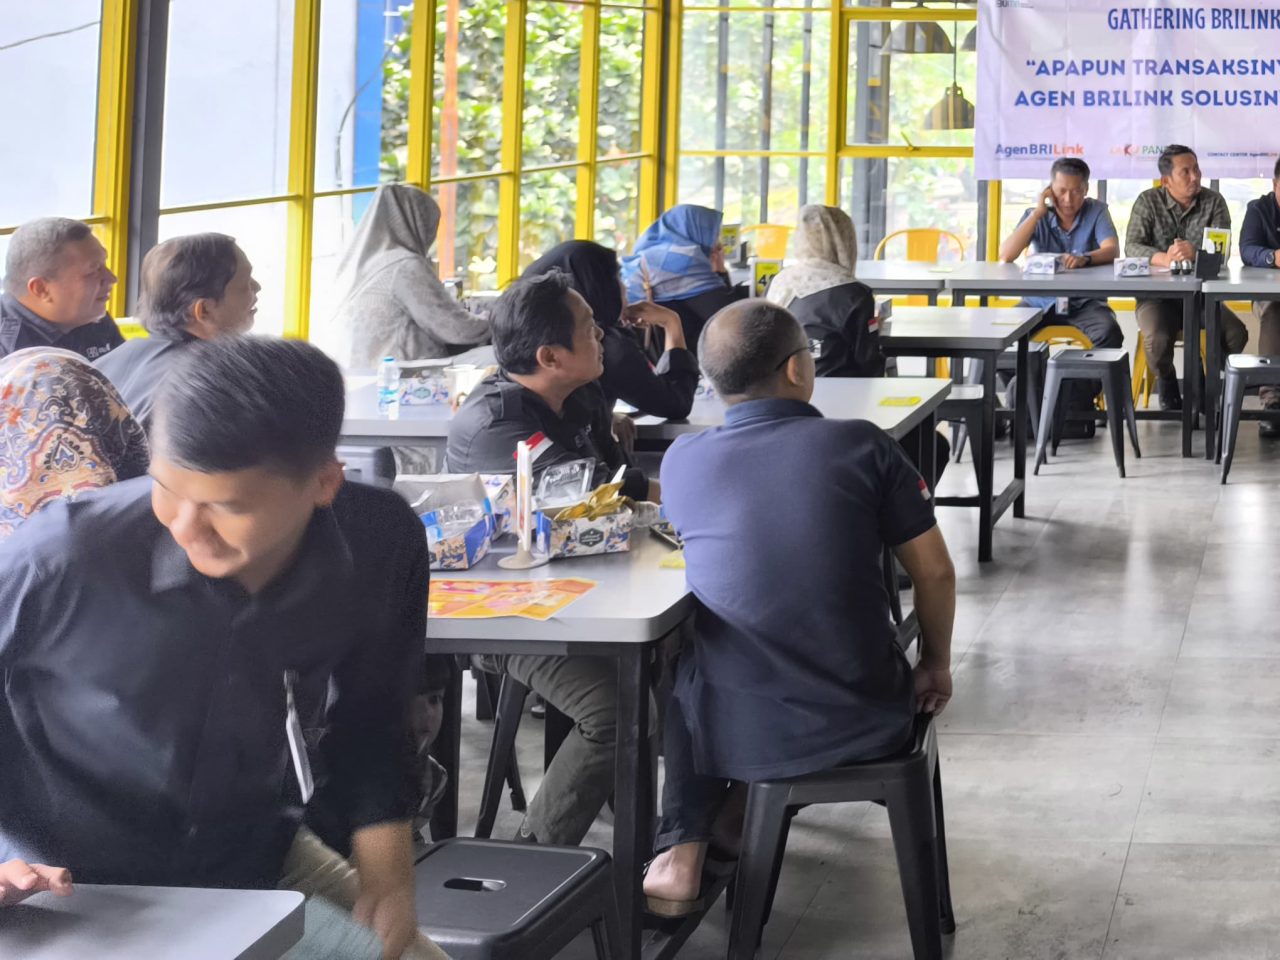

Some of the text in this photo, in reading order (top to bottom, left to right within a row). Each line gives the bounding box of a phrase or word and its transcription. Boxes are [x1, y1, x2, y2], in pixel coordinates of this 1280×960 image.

[1107, 8, 1205, 30] GATHERING
[1014, 90, 1075, 107] AGEN
[1083, 90, 1174, 107] BRILINK
